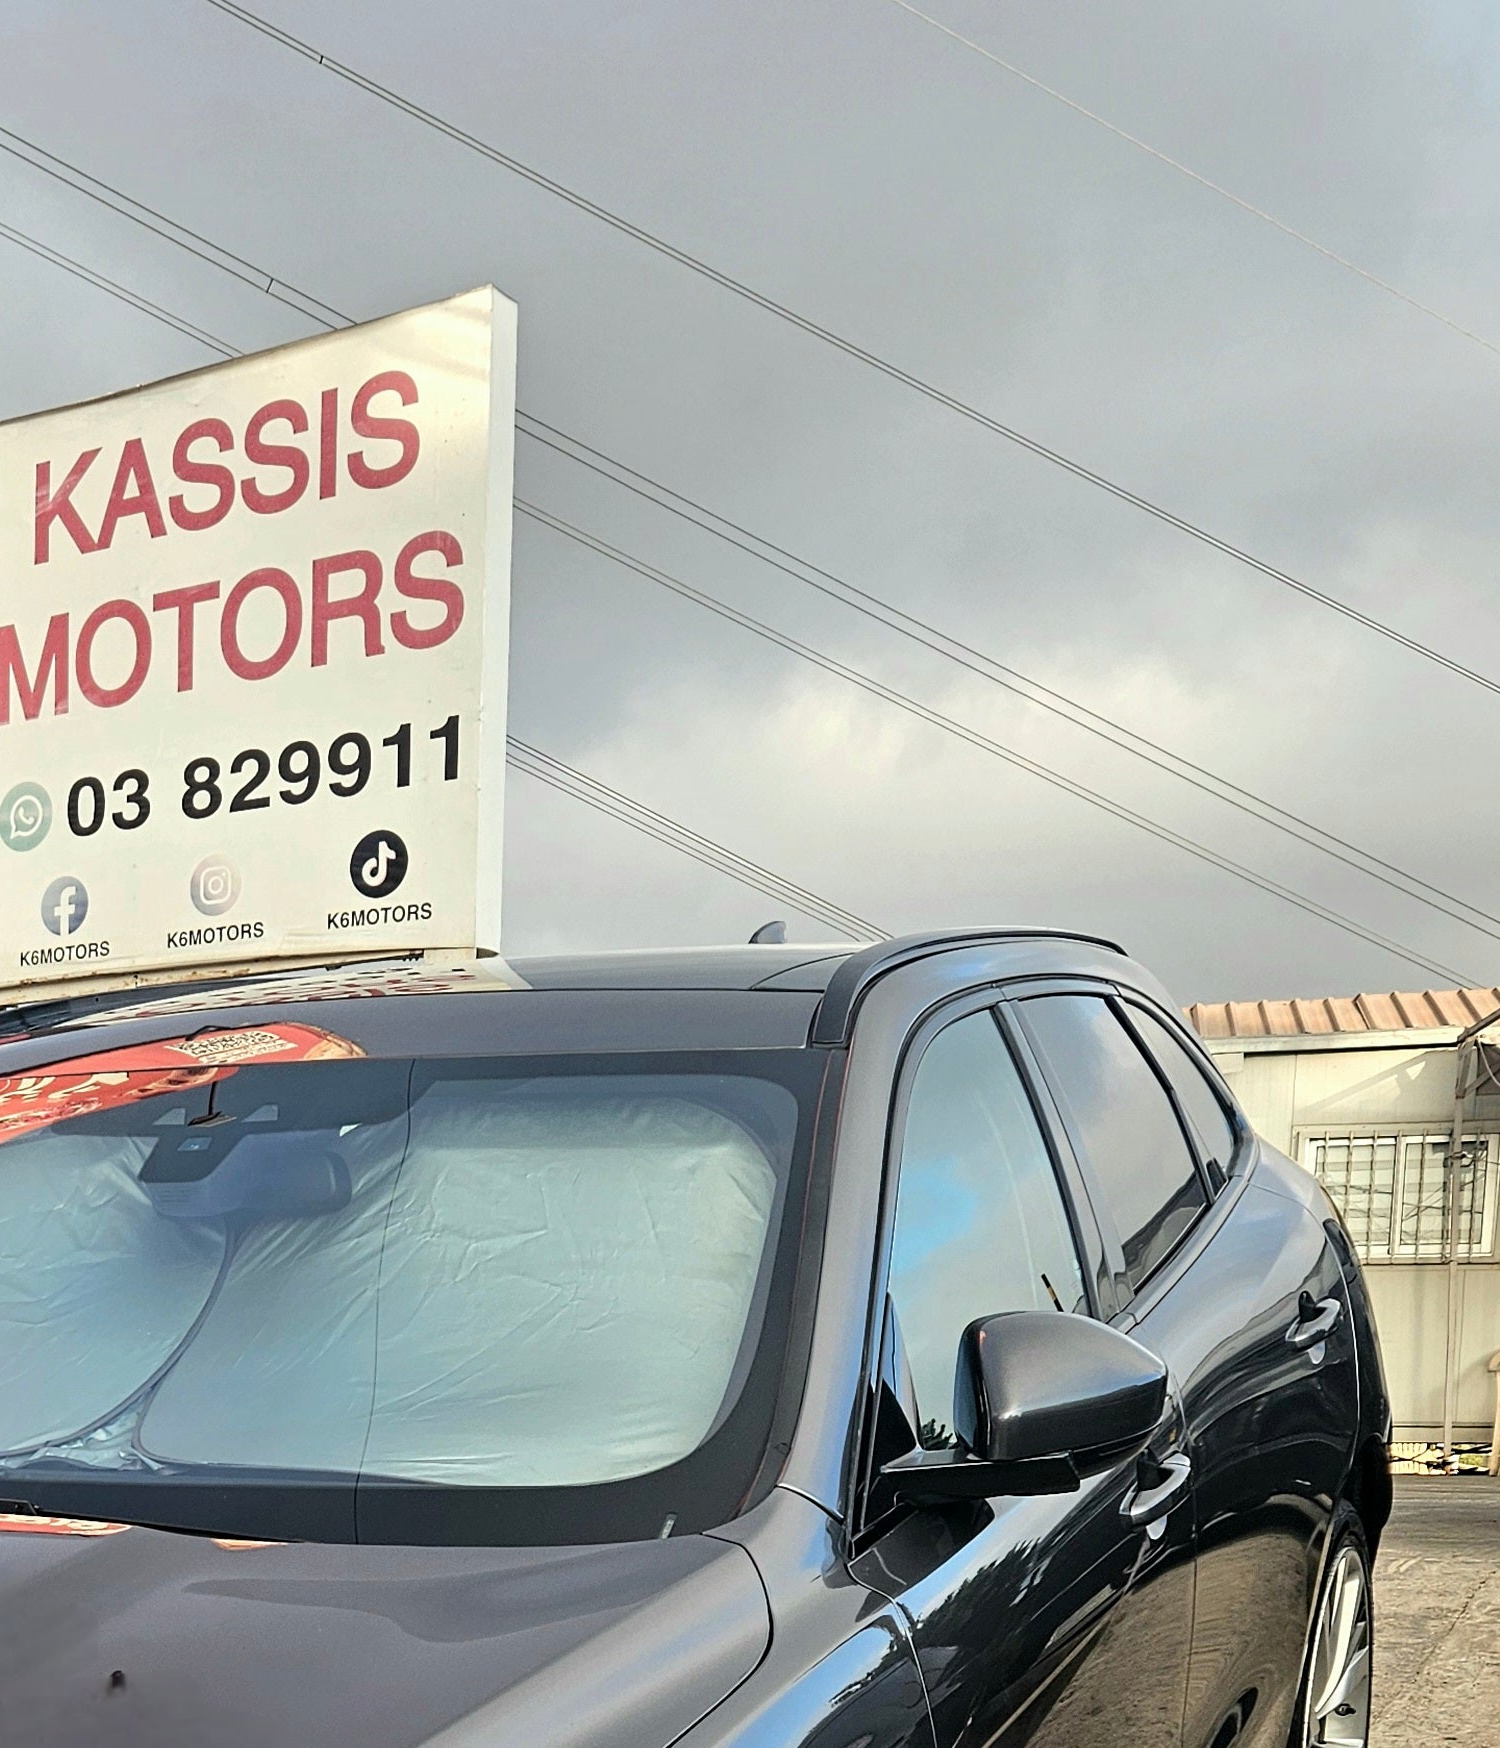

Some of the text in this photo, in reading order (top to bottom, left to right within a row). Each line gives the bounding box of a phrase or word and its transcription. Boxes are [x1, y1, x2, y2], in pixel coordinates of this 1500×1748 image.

[34, 372, 420, 564] KASSIS
[67, 714, 460, 837] 03 829911
[327, 902, 432, 930] K6MOTORS
[167, 921, 264, 949] K6MOTORS
[20, 940, 110, 967] K6MOTORS
